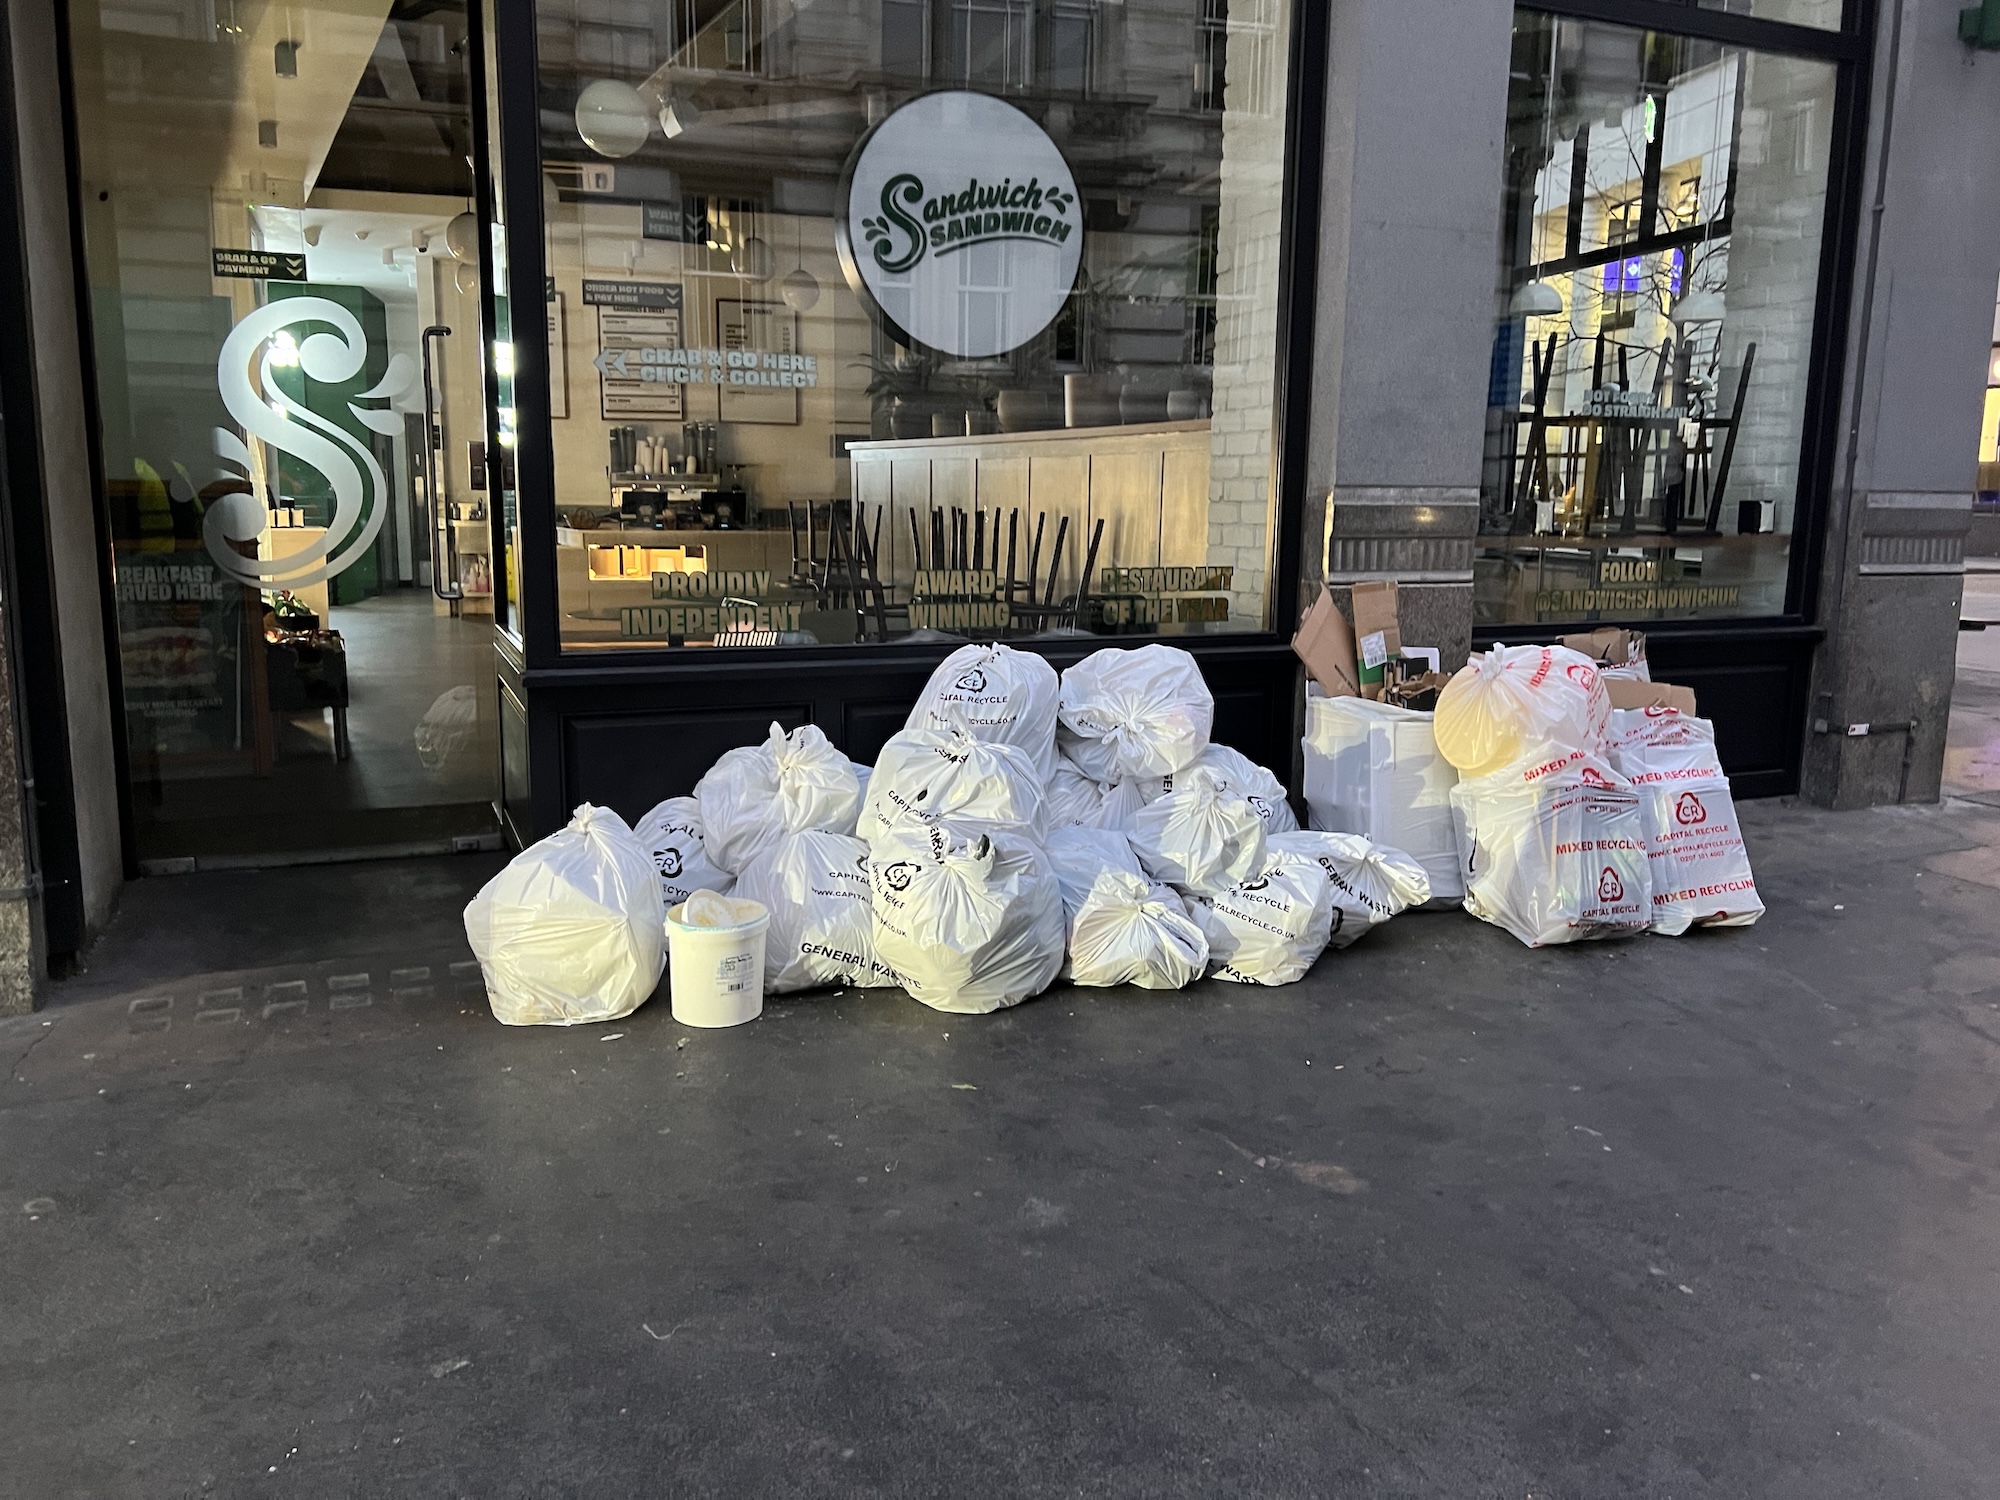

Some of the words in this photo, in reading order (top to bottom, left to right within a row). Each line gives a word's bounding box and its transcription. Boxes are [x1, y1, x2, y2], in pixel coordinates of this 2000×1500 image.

[649, 209, 680, 222] WAIT
[873, 173, 1042, 273] Sandwich
[649, 223, 682, 235] HERE
[930, 211, 1072, 247] SANDWICH
[217, 264, 269, 275] PAYMENT
[585, 283, 617, 292] ORDER
[618, 285, 637, 294] HOT
[639, 286, 664, 295] FOOD
[594, 294, 613, 302] PAY
[614, 295, 639, 303] HERE
[640, 348, 703, 366] GRAB
[707, 350, 722, 366] &
[727, 352, 758, 368] GO
[763, 353, 816, 371] HERE
[640, 366, 704, 383] CLICK
[710, 368, 724, 384] &
[730, 370, 817, 388] COLLECT
[118, 565, 213, 584] REAKFAST
[1102, 566, 1234, 592] RESTAURANT
[1600, 561, 1658, 582] FOLLOW
[117, 583, 172, 601] ERVED
[175, 583, 223, 600] HERE
[652, 571, 771, 599] PROUDLY
[1535, 586, 1739, 611] @SANDWICHSANDWICHUK
[620, 605, 801, 636] INDEPENDENT
[908, 602, 1010, 629] WINNING
[1103, 599, 1131, 625] OF
[1135, 599, 1172, 624] THE
[1177, 598, 1229, 622] YEAR
[1524, 759, 1567, 781] MIXED
[1682, 805, 1699, 817] CR
[1655, 830, 1694, 843] CAPITAL
[1696, 825, 1729, 836] RECYCLE
[1556, 841, 1593, 855] MIXED
[1318, 857, 1354, 897] GENERAL
[1603, 882, 1618, 894] CR
[1242, 892, 1292, 914] RECYCLE
[1653, 889, 1697, 906] MIXED
[1699, 879, 1754, 897] RECYCLIN
[1582, 907, 1610, 917] CAPITAL
[1611, 904, 1640, 915] RECYCLE
[801, 942, 866, 968] GENERAL
